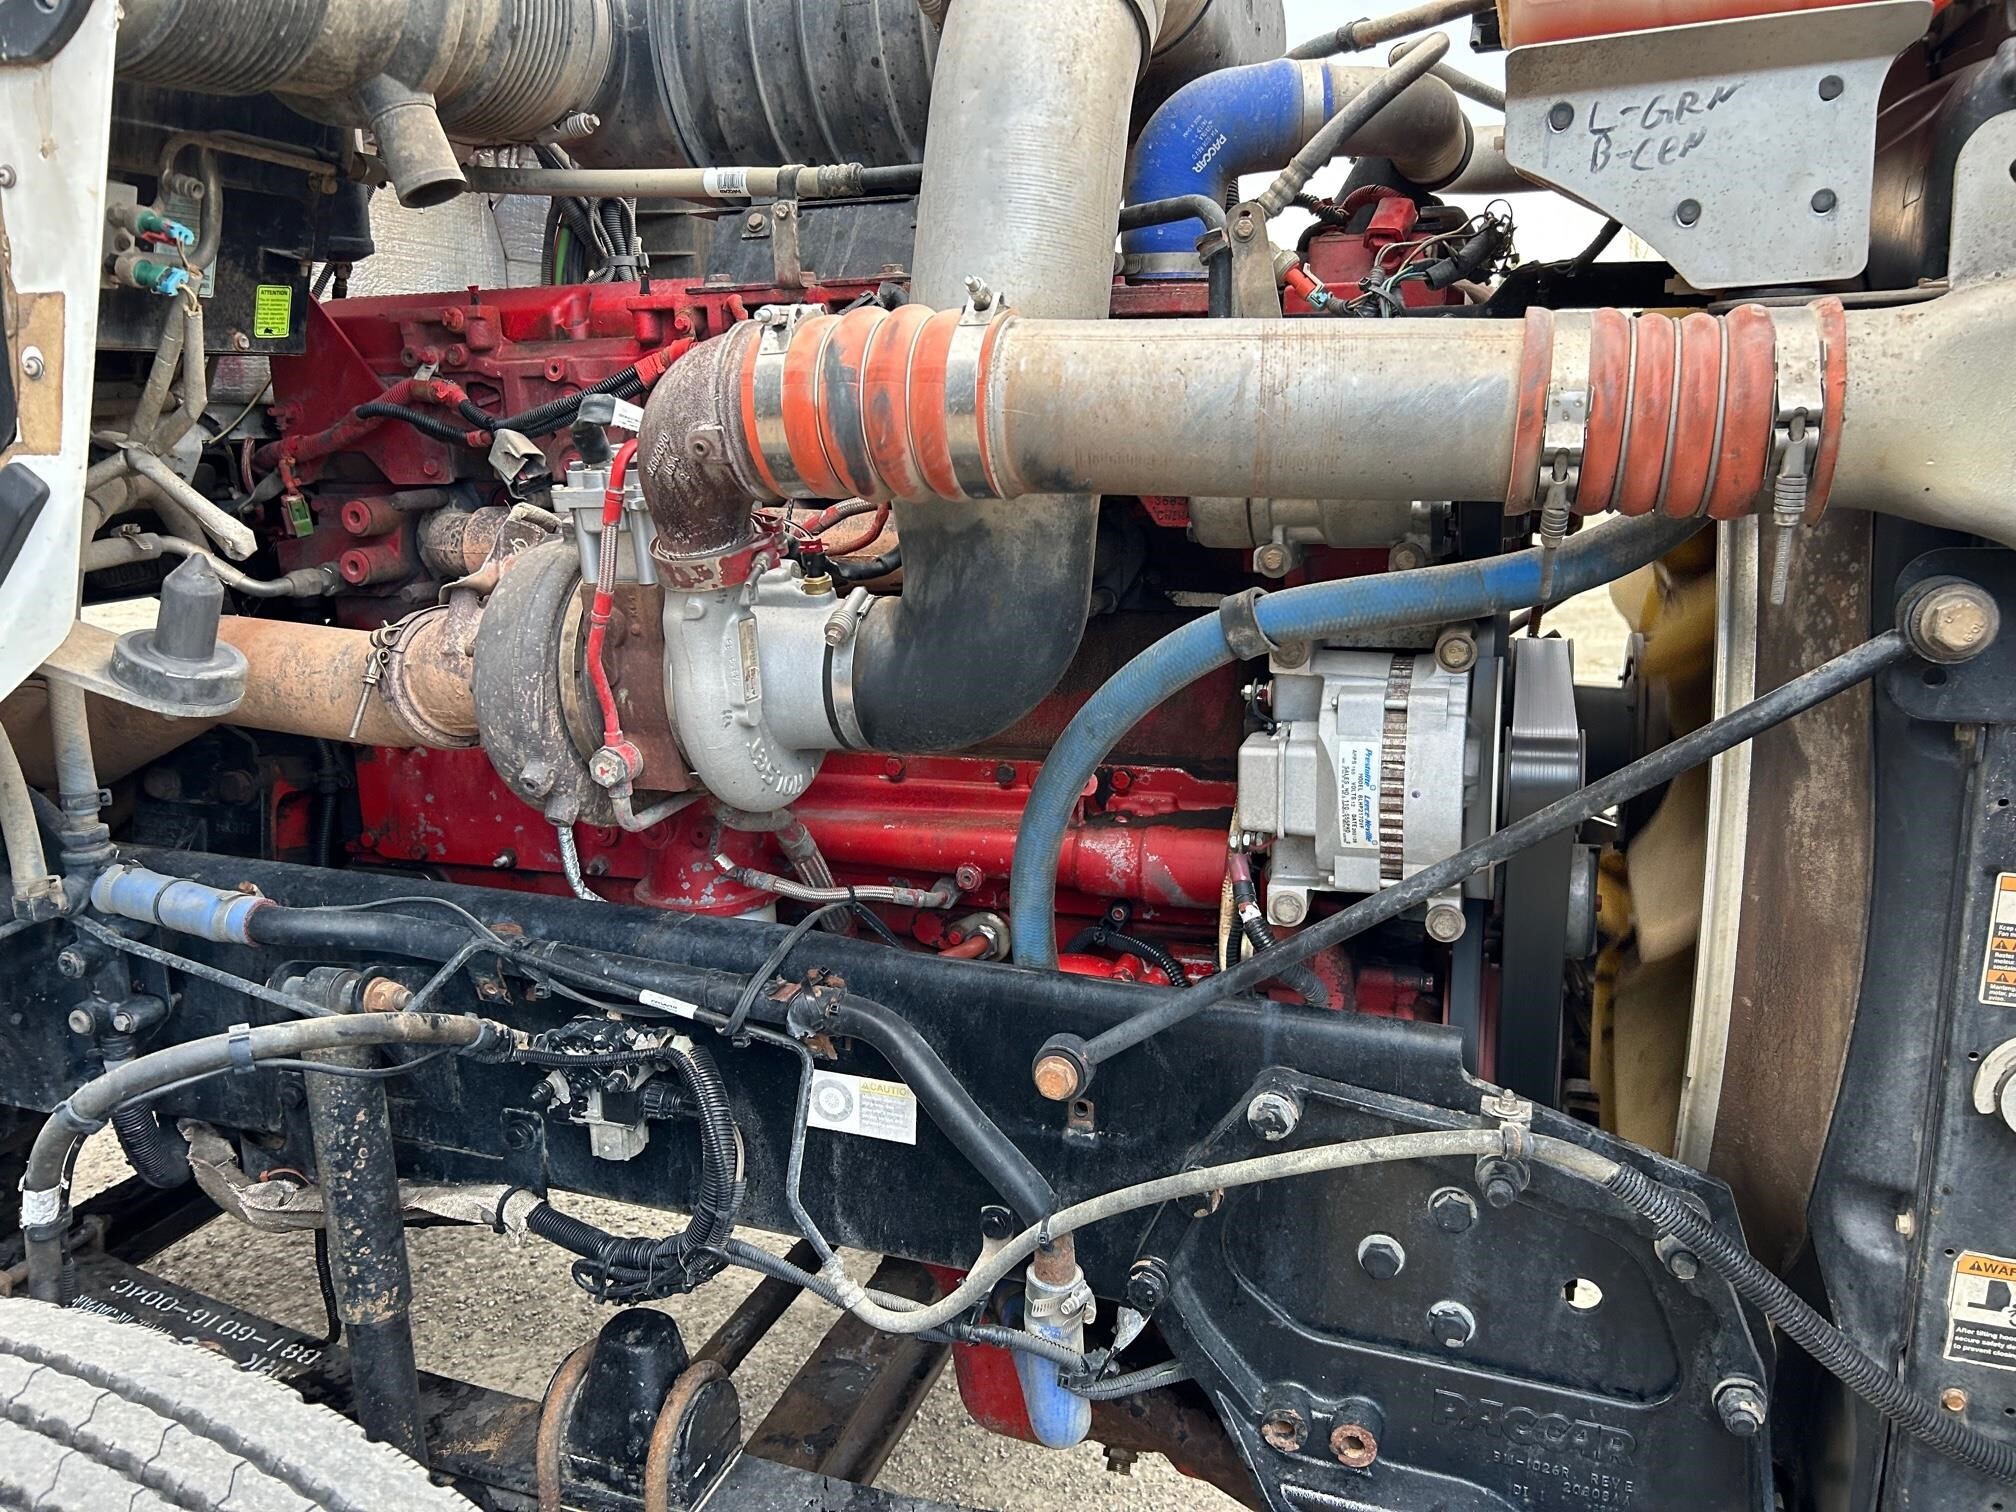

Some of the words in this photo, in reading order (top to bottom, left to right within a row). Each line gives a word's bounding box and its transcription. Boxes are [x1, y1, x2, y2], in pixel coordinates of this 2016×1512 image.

[1192, 134, 1227, 173] PACCAR
[664, 455, 680, 476] USA
[1364, 748, 1373, 787] Prestolite
[1364, 795, 1372, 842] Leece-Neville
[870, 1083, 909, 1097] CAUTIO
[1954, 1335, 1980, 1345] secure
[1981, 1340, 2005, 1349] safety
[1956, 1326, 1975, 1335] After
[1976, 1329, 1998, 1340] tilting
[1962, 1345, 1992, 1355] prevent
[1431, 1388, 1638, 1467] PACCAR
[1590, 1472, 1620, 1490] REV
